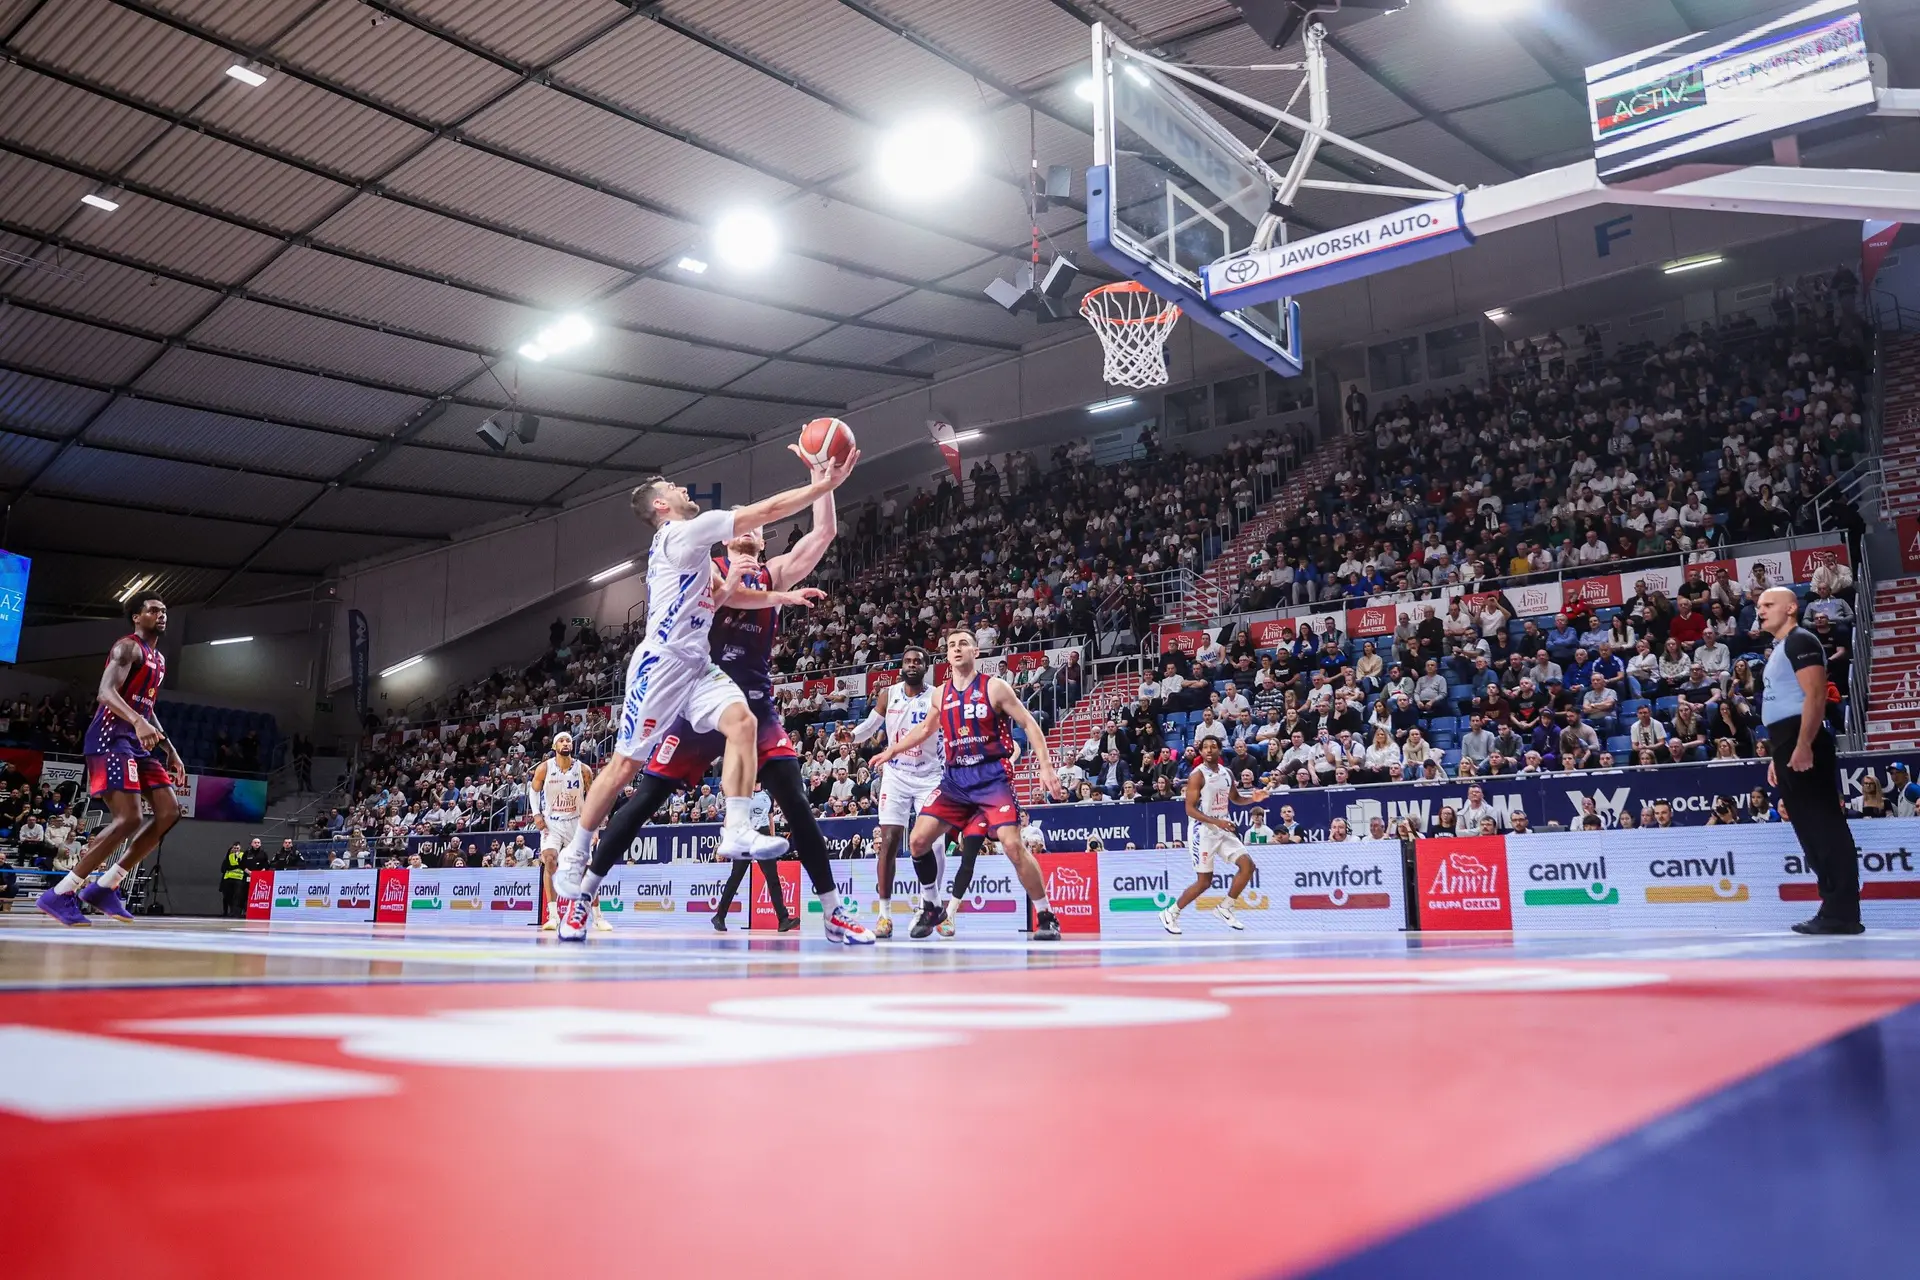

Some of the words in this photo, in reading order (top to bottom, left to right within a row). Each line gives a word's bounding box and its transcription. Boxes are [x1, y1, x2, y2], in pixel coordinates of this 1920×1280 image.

[1594, 213, 1633, 258] F
[1279, 232, 1371, 268] JAWORSKI
[964, 703, 988, 719] 28
[567, 780, 580, 789] 14
[1529, 856, 1607, 881] canvil
[1649, 851, 1736, 878] canvil
[1113, 870, 1169, 891] canvil
[1294, 865, 1383, 888] anvifort
[1428, 859, 1497, 894] Anwil
[278, 883, 299, 896] canvil
[308, 883, 330, 896] canvil
[340, 882, 370, 896] anvifort
[415, 882, 440, 896] canvil
[452, 882, 480, 896] canvil
[493, 881, 531, 896] anvifort
[637, 880, 672, 896] canvil
[1066, 904, 1092, 915] ORLEN
[1464, 899, 1500, 910] ORLEN
